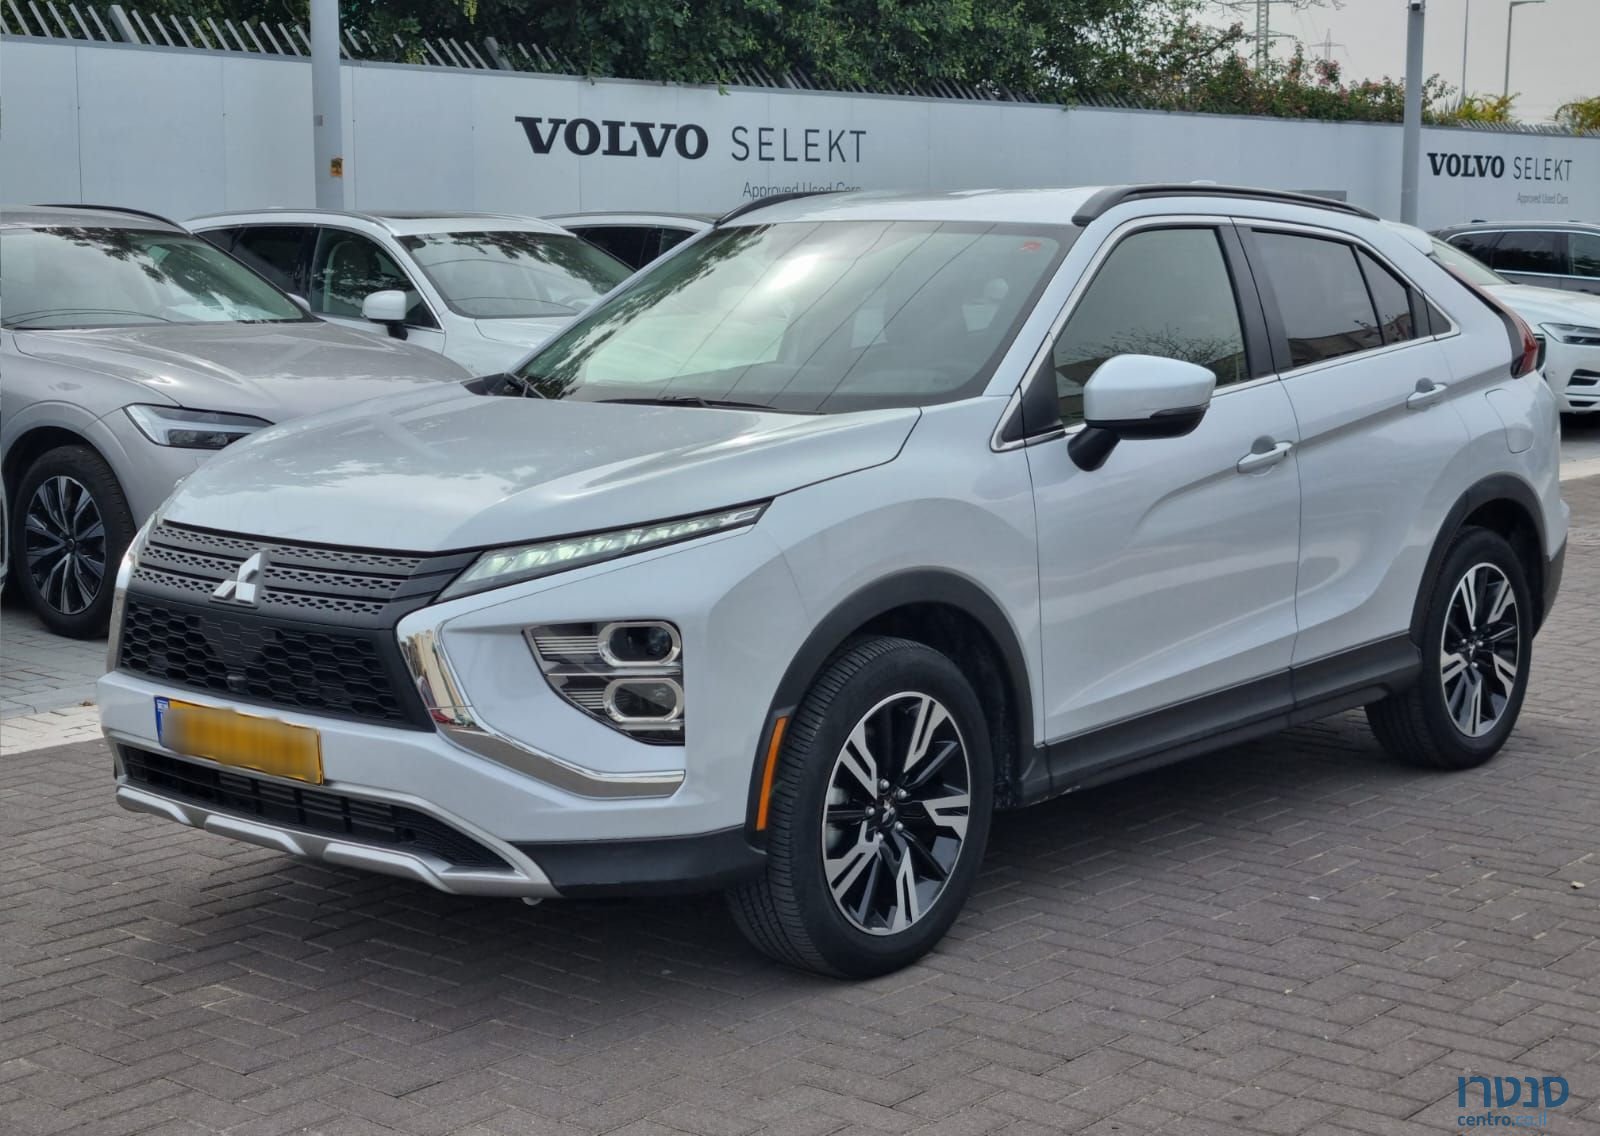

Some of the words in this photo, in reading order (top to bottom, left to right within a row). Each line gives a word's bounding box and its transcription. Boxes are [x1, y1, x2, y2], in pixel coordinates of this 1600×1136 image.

[515, 116, 709, 160] VOLVO
[731, 126, 867, 163] SELEKT
[1427, 152, 1505, 178] VOLVO
[1513, 156, 1573, 181] SELEKT
